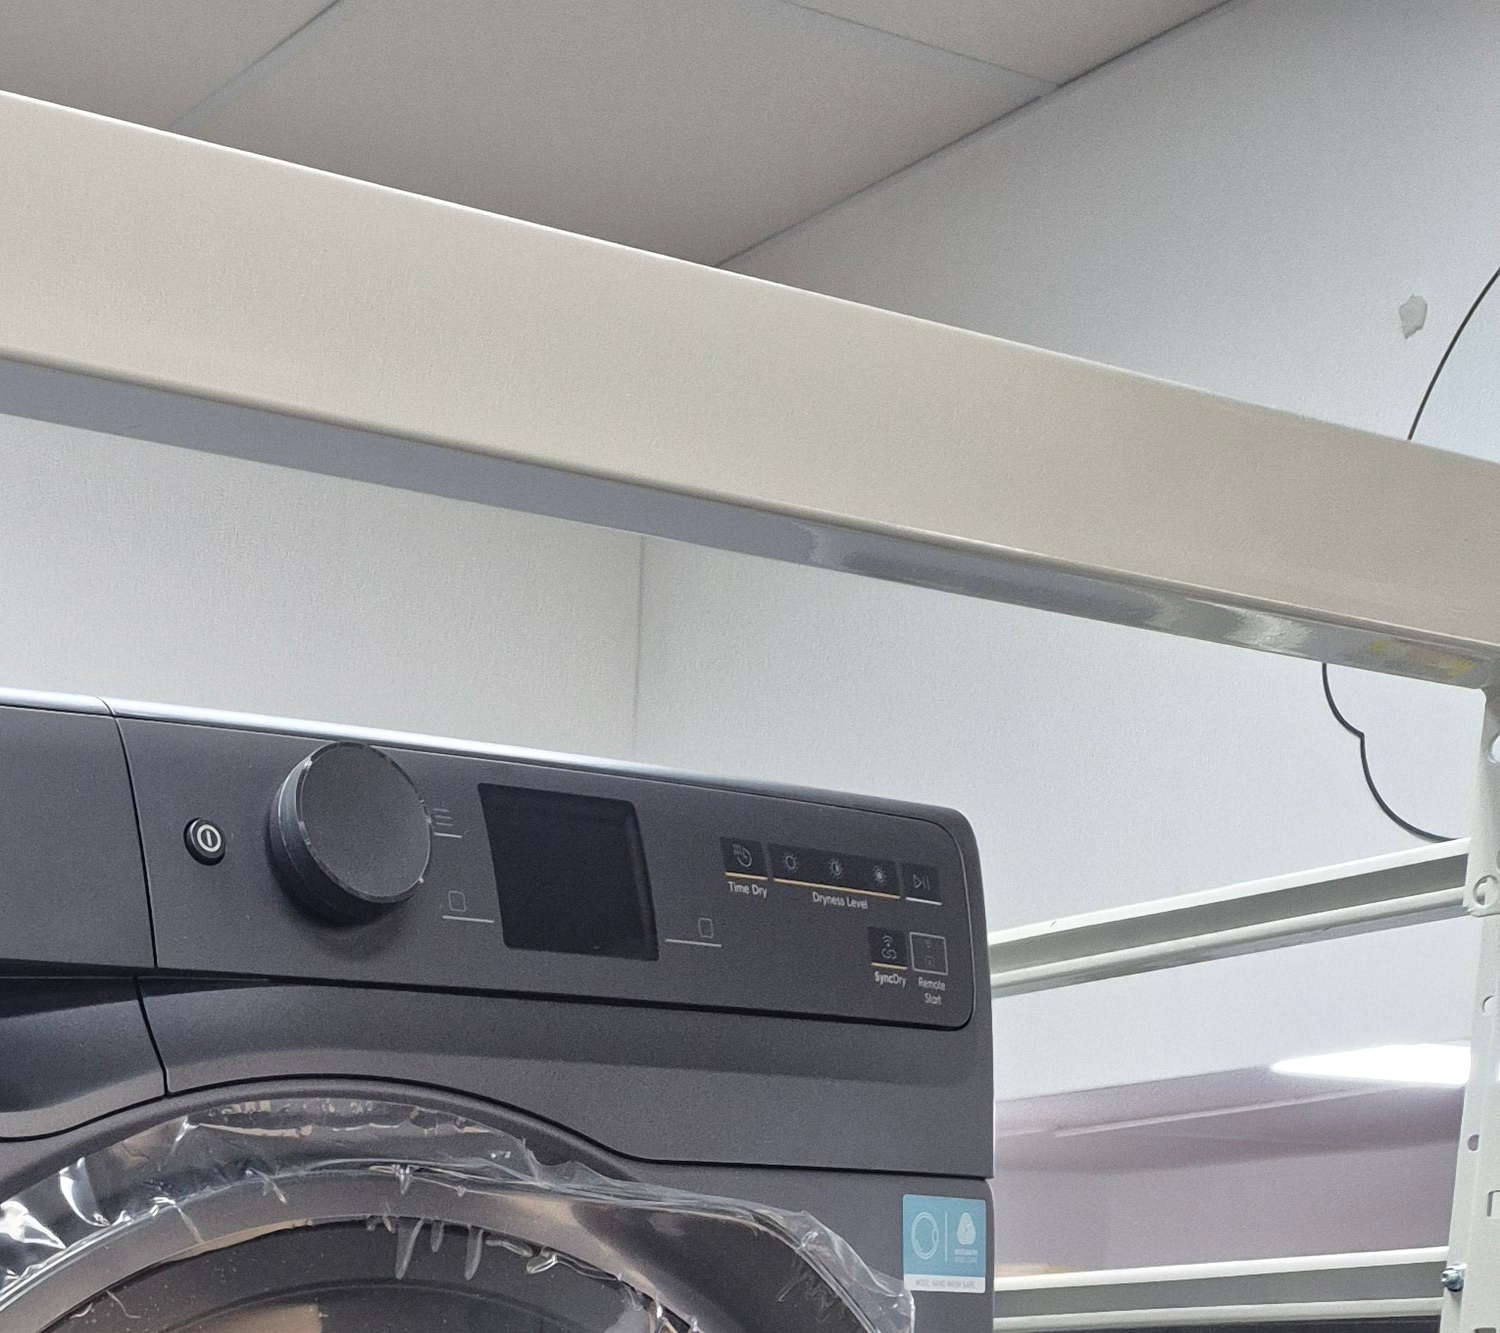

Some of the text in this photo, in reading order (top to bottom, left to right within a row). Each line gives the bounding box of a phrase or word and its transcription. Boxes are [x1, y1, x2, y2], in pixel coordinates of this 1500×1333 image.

[728, 881, 767, 899] Time Dry
[813, 892, 868, 909] Dryness Level
[874, 971, 906, 987] SyncDry
[918, 977, 946, 991] Remote
